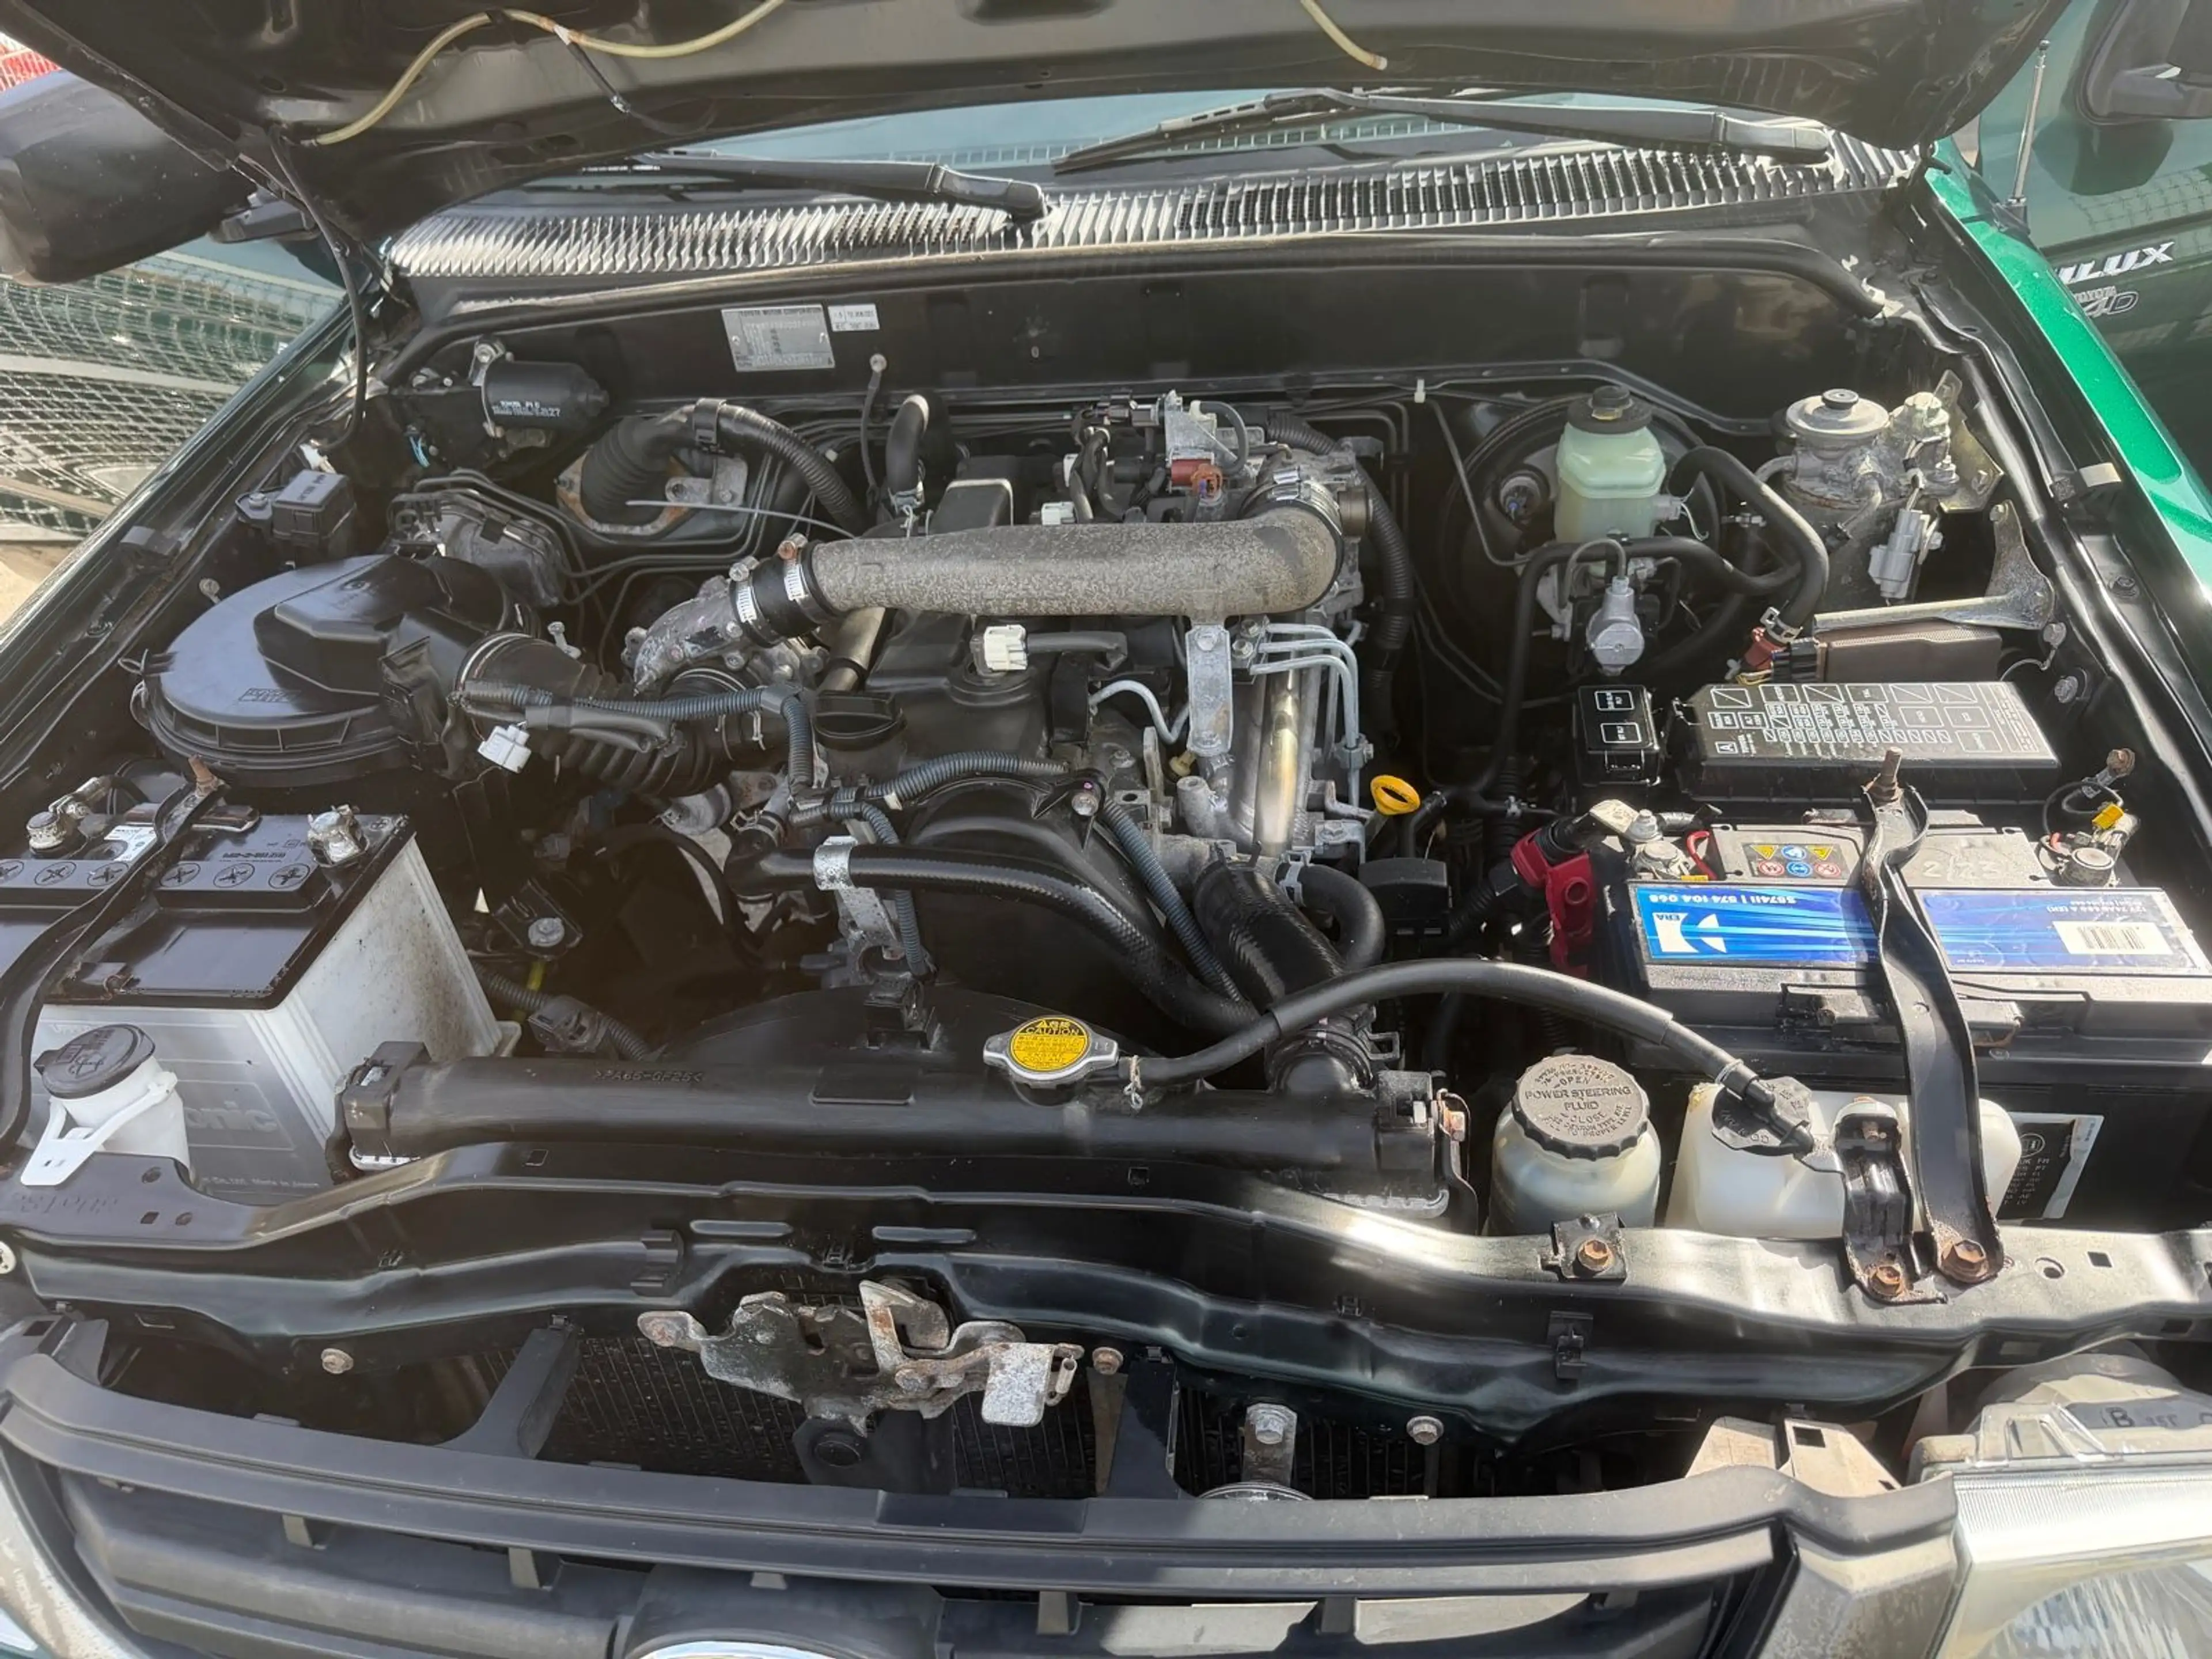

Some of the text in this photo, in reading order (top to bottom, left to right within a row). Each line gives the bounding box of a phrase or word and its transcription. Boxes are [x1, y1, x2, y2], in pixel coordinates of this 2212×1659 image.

[2055, 241, 2175, 285] ILUX
[1713, 895, 1738, 904] 574
[1025, 1027, 1080, 1036] CAUTION
[1559, 1075, 1592, 1086] OPEN
[1525, 1086, 1632, 1100] POWER STEERING
[1563, 1100, 1600, 1111] FLUID
[1570, 1111, 1607, 1124] CLOSE
